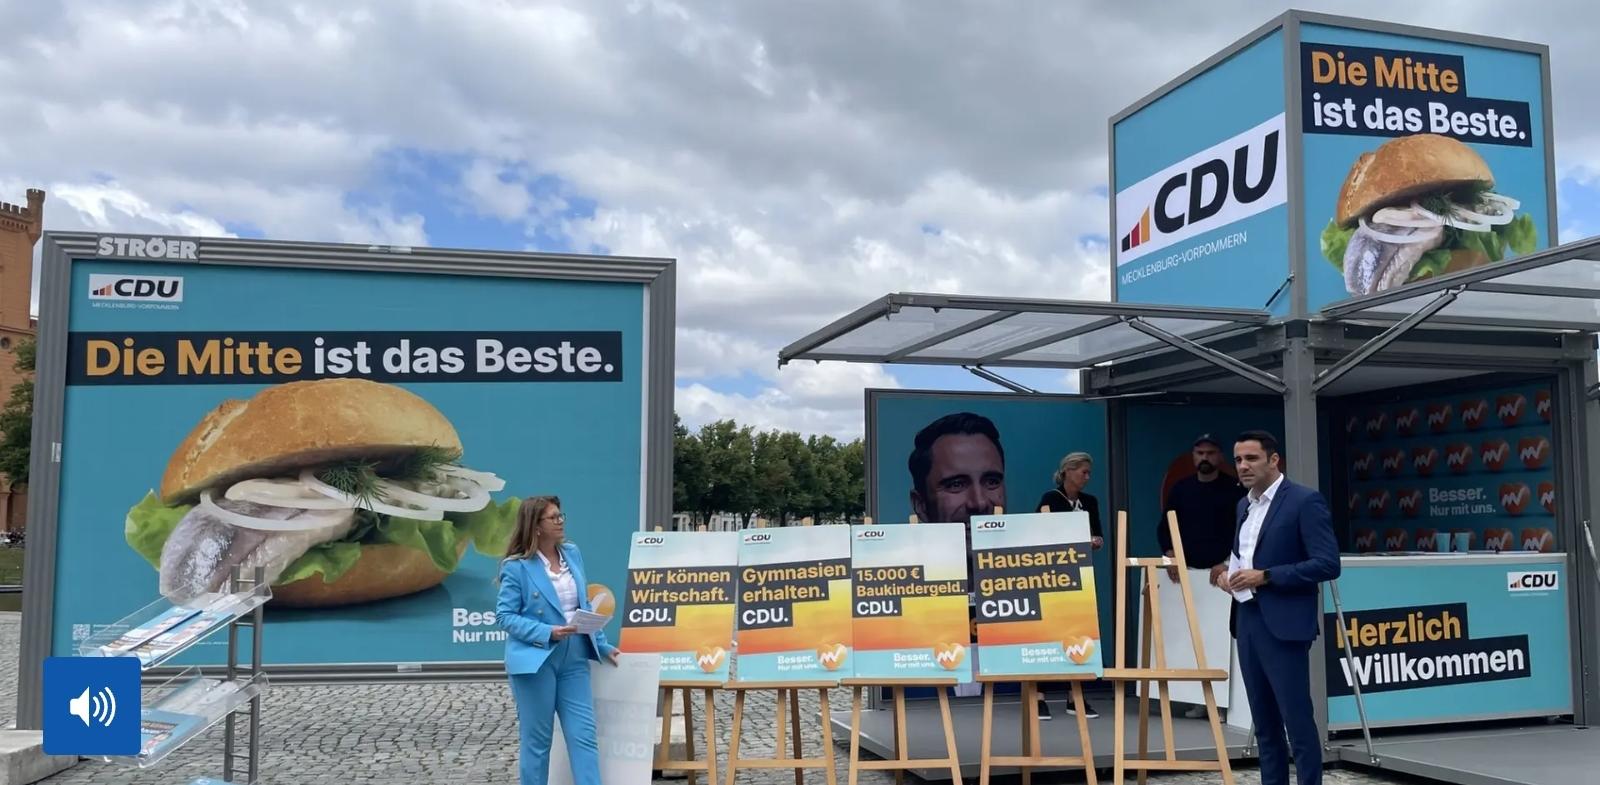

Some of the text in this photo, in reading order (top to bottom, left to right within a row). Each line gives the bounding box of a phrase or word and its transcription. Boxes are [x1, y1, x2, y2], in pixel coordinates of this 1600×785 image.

[1311, 50, 1460, 94] Die Mitte
[1313, 93, 1526, 140] ist das Beste.
[1154, 129, 1279, 234] CDU
[98, 236, 197, 260] STRÖER
[1121, 230, 1248, 285] MECKLENBURG-VORPOMMERN
[114, 278, 179, 298] CDU
[86, 337, 614, 377] Die Mitte ist das Beste.
[1428, 487, 1487, 503] Besser.
[1429, 503, 1496, 517] Nur mit uns.
[983, 521, 1005, 529] CDU
[751, 534, 771, 542] CDU
[864, 530, 885, 538] CDU
[977, 547, 1087, 570] Hausarzt-
[633, 569, 730, 585] Wir können
[742, 562, 847, 586] Gymnasien
[856, 568, 920, 582] 15.000 €
[1521, 573, 1556, 588] CDU
[856, 581, 965, 598] Baukindergeld.
[980, 570, 1077, 596] garantie.
[632, 587, 729, 604] Wirtschaft.
[742, 585, 825, 603] erhalten.
[629, 607, 672, 624] CDU.
[742, 607, 789, 625] CDU.
[856, 601, 898, 616] CDU.
[981, 598, 1036, 618] CDU.
[452, 607, 497, 627] Bes
[452, 629, 481, 643] Nur
[1336, 610, 1461, 649] Herzlich
[778, 655, 814, 665] Besser.
[893, 652, 931, 662] Besser.
[1021, 647, 1060, 657] Besser.
[1022, 656, 1036, 665] Nur
[894, 661, 907, 669] Nur
[1339, 648, 1524, 687] Willkommen
